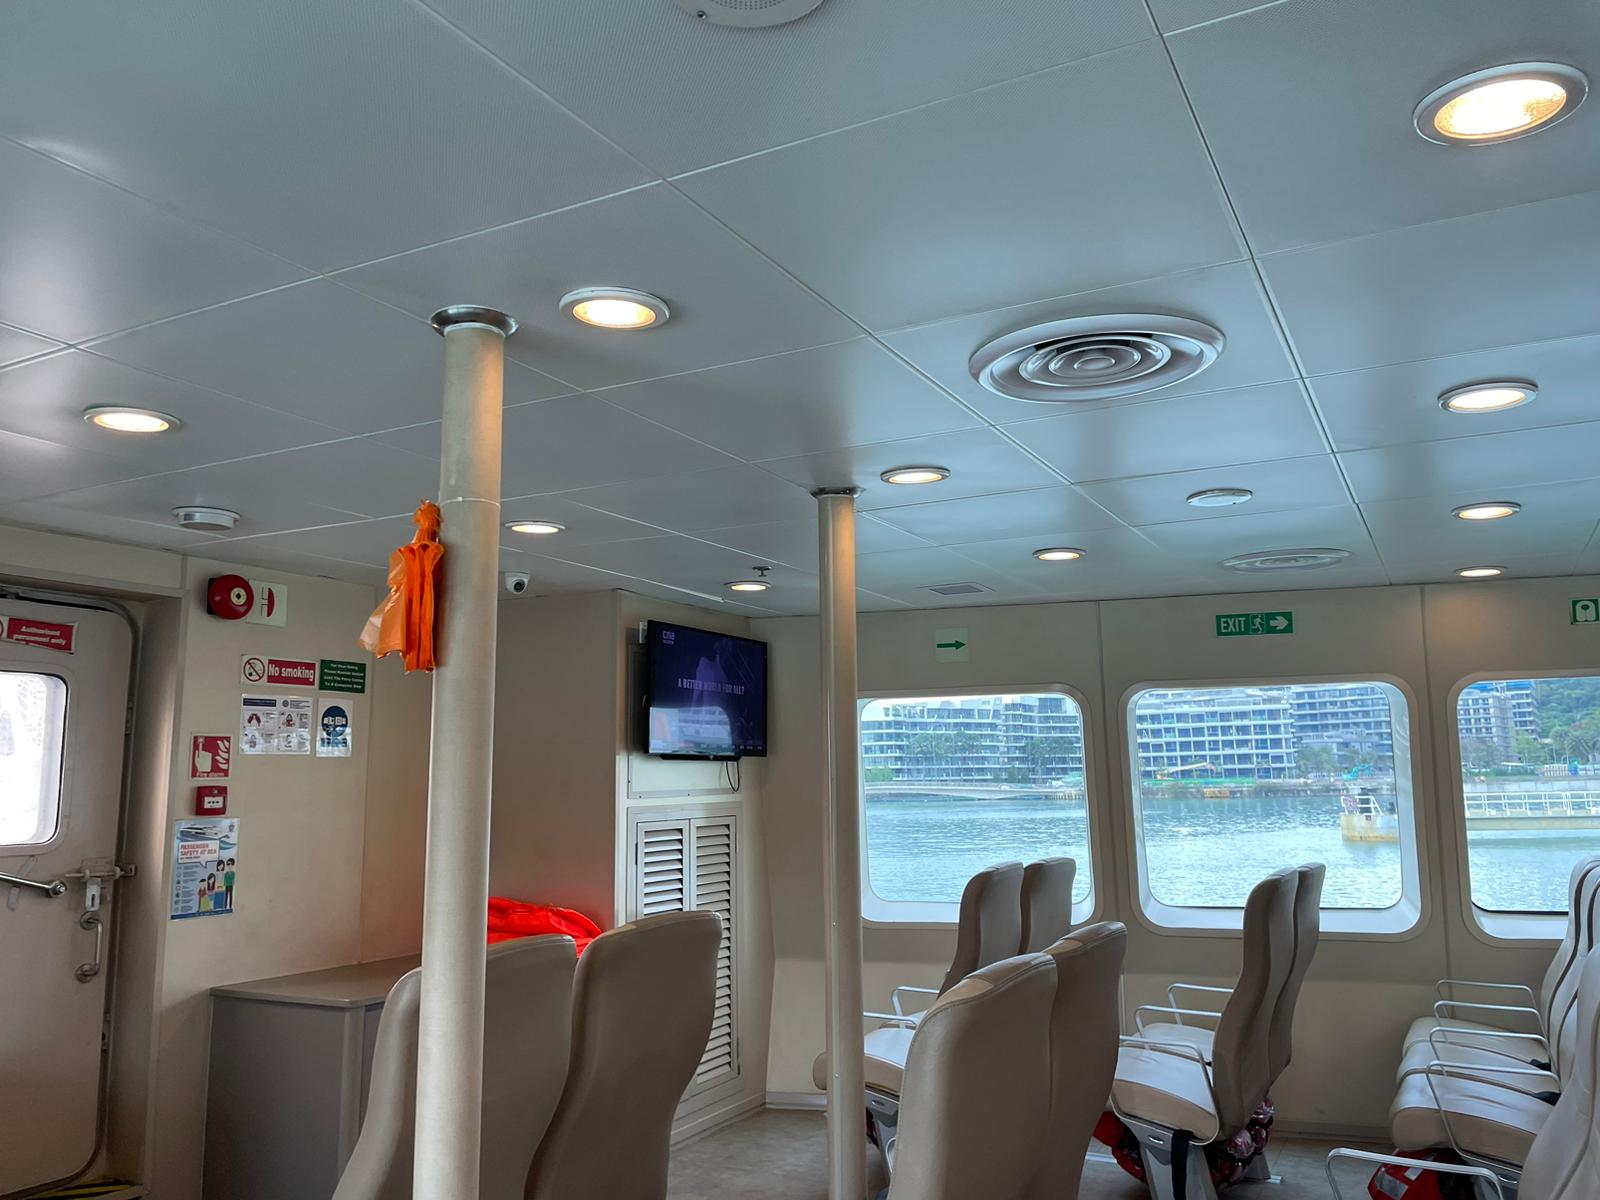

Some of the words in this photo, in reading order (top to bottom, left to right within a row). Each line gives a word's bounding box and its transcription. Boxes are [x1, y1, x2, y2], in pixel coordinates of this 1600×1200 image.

[1220, 617, 1246, 632] EXIT
[50, 638, 67, 646] only
[268, 663, 280, 677] No
[281, 667, 315, 682] smoking
